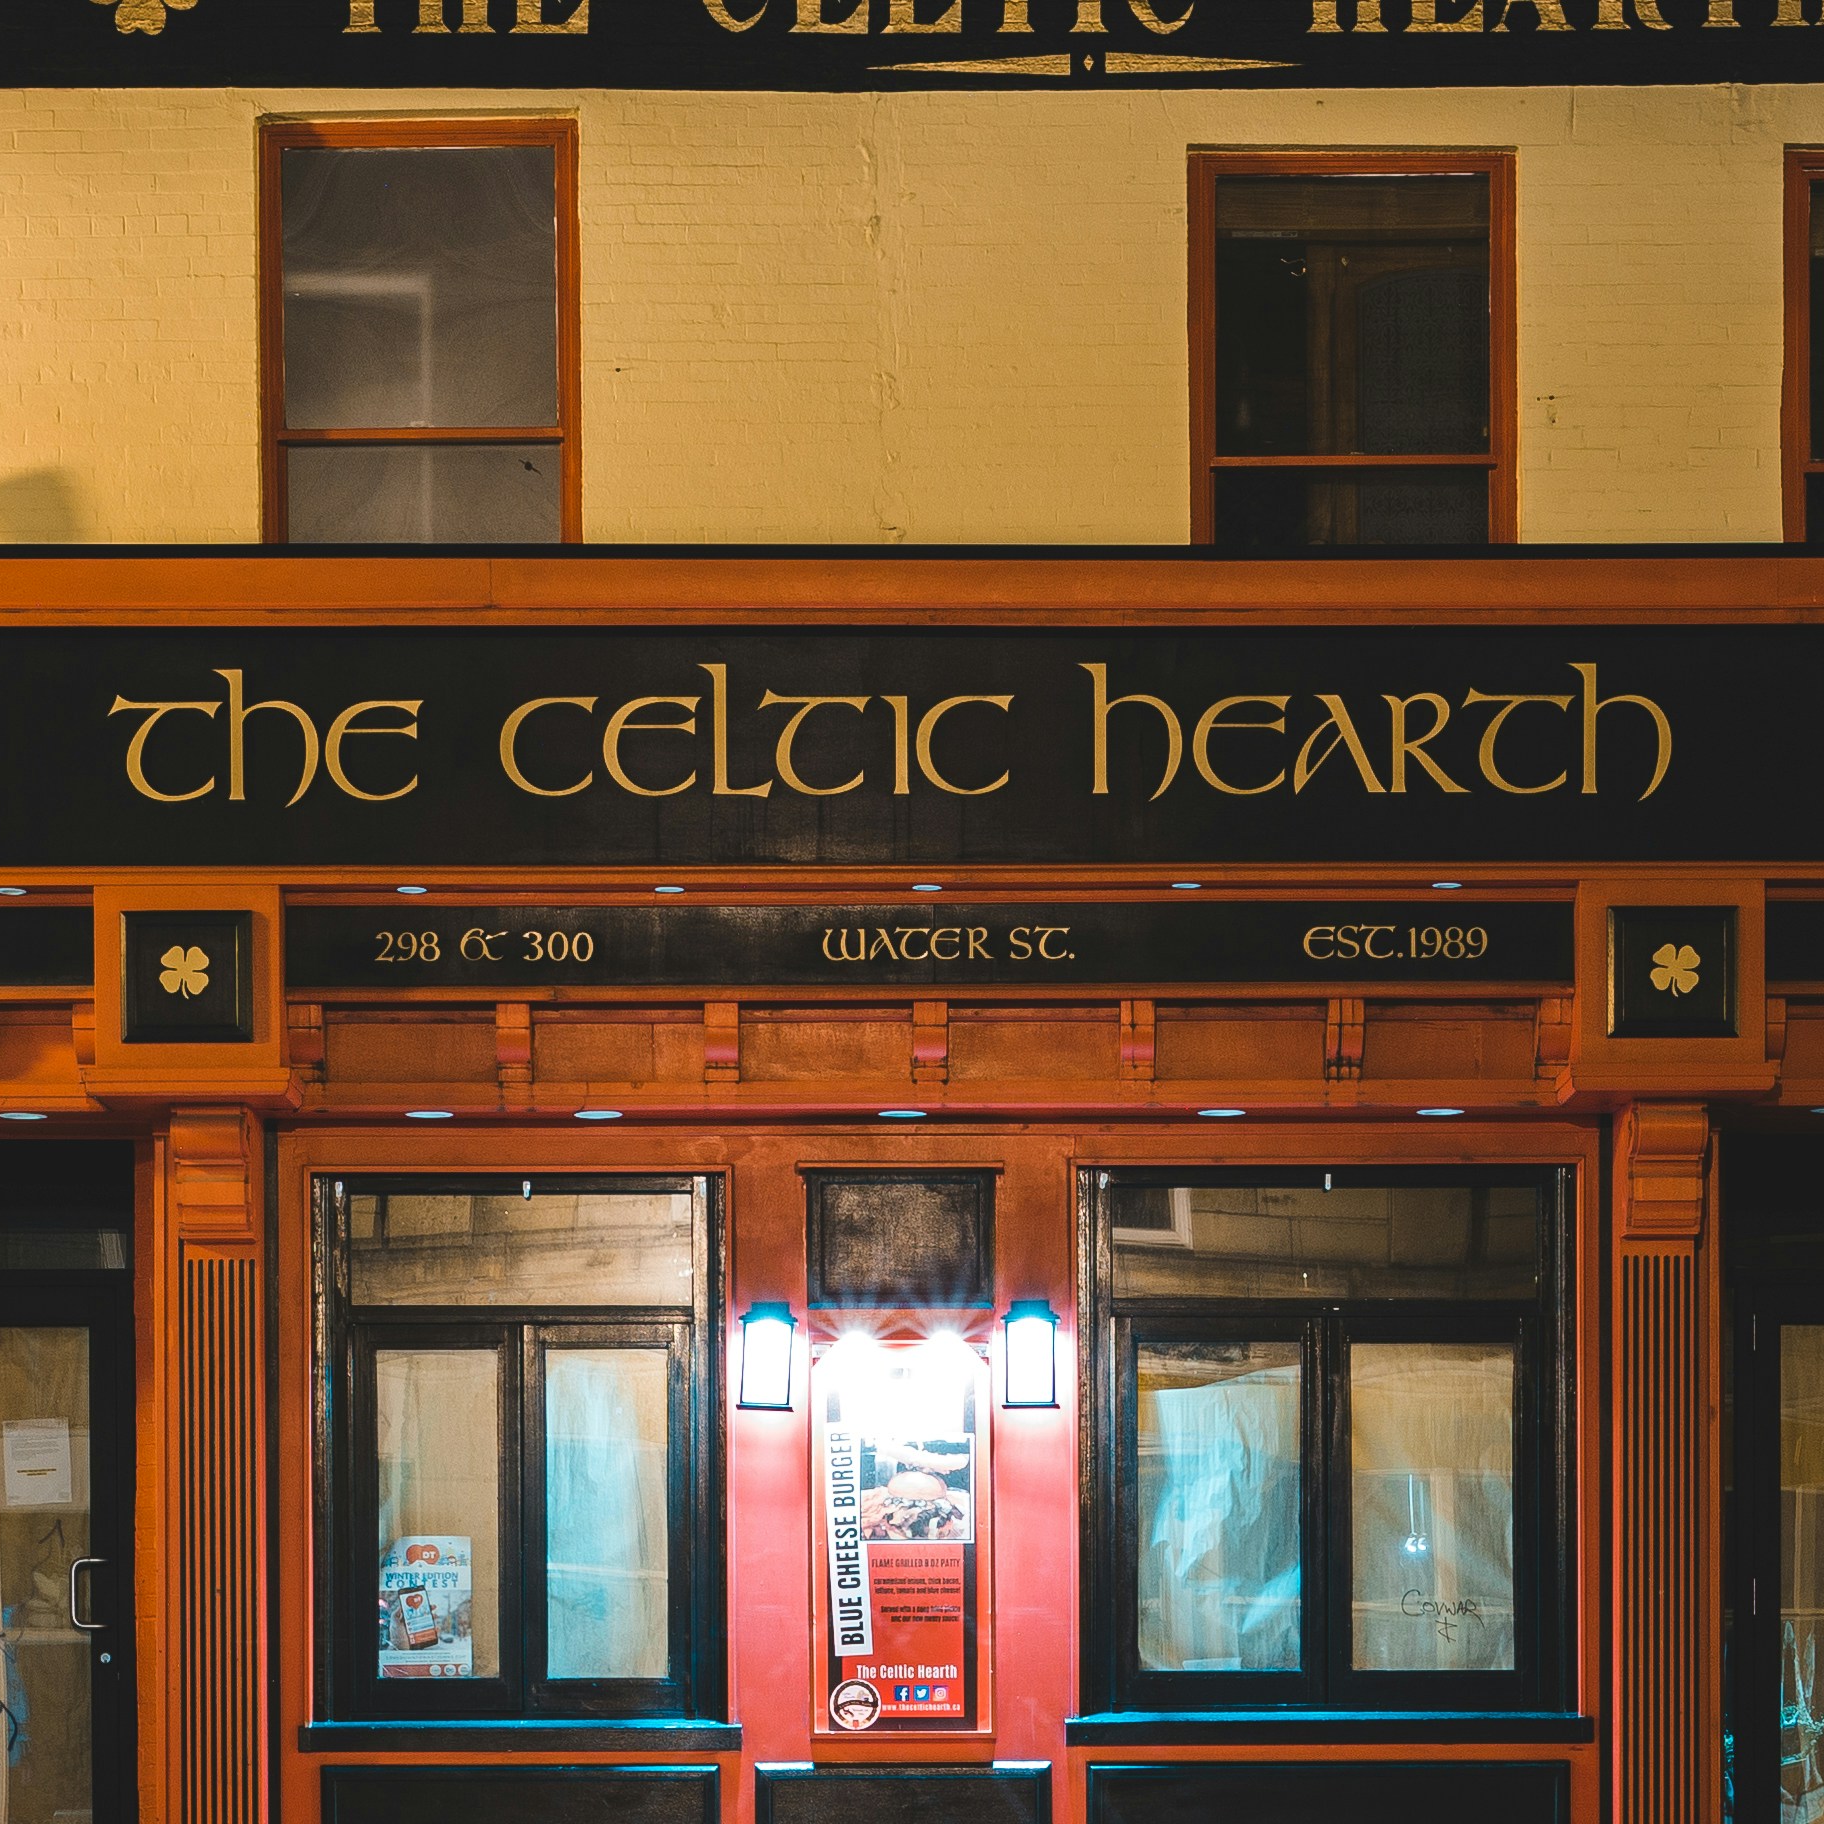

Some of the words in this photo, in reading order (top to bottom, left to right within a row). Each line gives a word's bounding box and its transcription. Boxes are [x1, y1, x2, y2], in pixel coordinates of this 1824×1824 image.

[108, 669, 425, 808] THE
[499, 664, 1015, 798] CELTIC
[1079, 663, 1673, 802] HEARTH
[375, 931, 442, 963] 298
[460, 929, 509, 962] &
[522, 931, 595, 963] 300
[822, 927, 992, 962] WATER
[1009, 926, 1076, 961] ST.
[830, 1432, 856, 1508] BURGER
[422, 1550, 436, 1560] DT
[834, 1514, 861, 1590] CHEESE
[871, 1558, 894, 1568] FLAME
[895, 1558, 923, 1568] GRILLED
[940, 1558, 961, 1568] PATTY
[385, 1571, 420, 1581] WINTER
[421, 1571, 458, 1580] EDITION
[385, 1579, 459, 1589] CONTEST
[839, 1596, 865, 1646] BLUE
[856, 1664, 877, 1679] The
[879, 1664, 915, 1679] Celtic
[917, 1664, 957, 1679] Hearth
